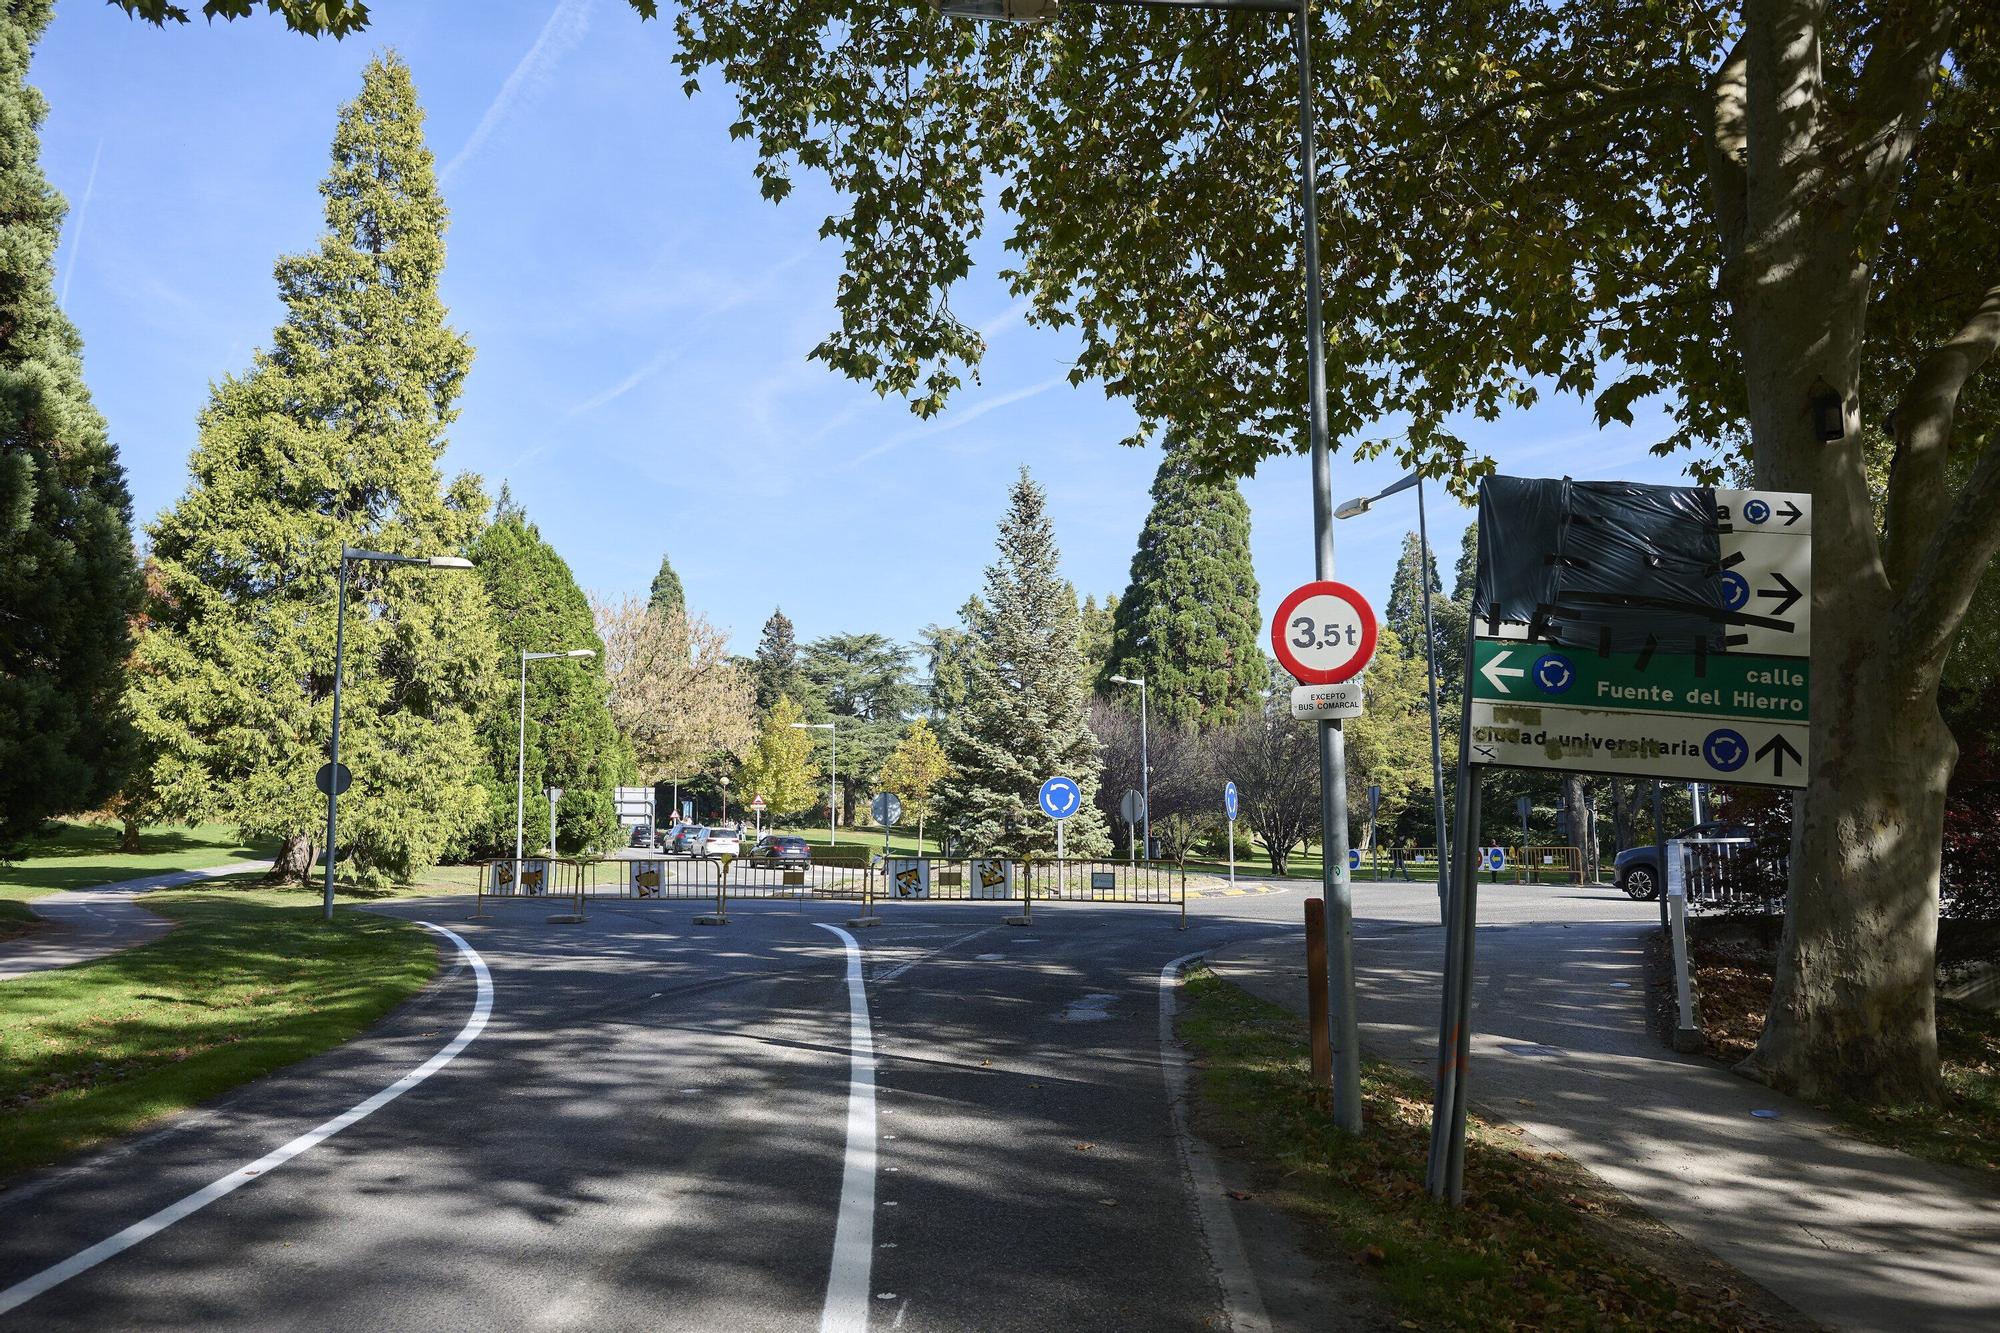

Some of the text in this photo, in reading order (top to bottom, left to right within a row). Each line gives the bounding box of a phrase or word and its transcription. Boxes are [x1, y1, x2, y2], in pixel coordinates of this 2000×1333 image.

[1746, 668, 1804, 687] calle
[1310, 692, 1346, 701] EXCEPTO
[1596, 680, 1804, 712] Fuente del Hierro
[1298, 701, 1359, 711] BUS COMARCAL
[1558, 732, 1700, 757] universitaria
